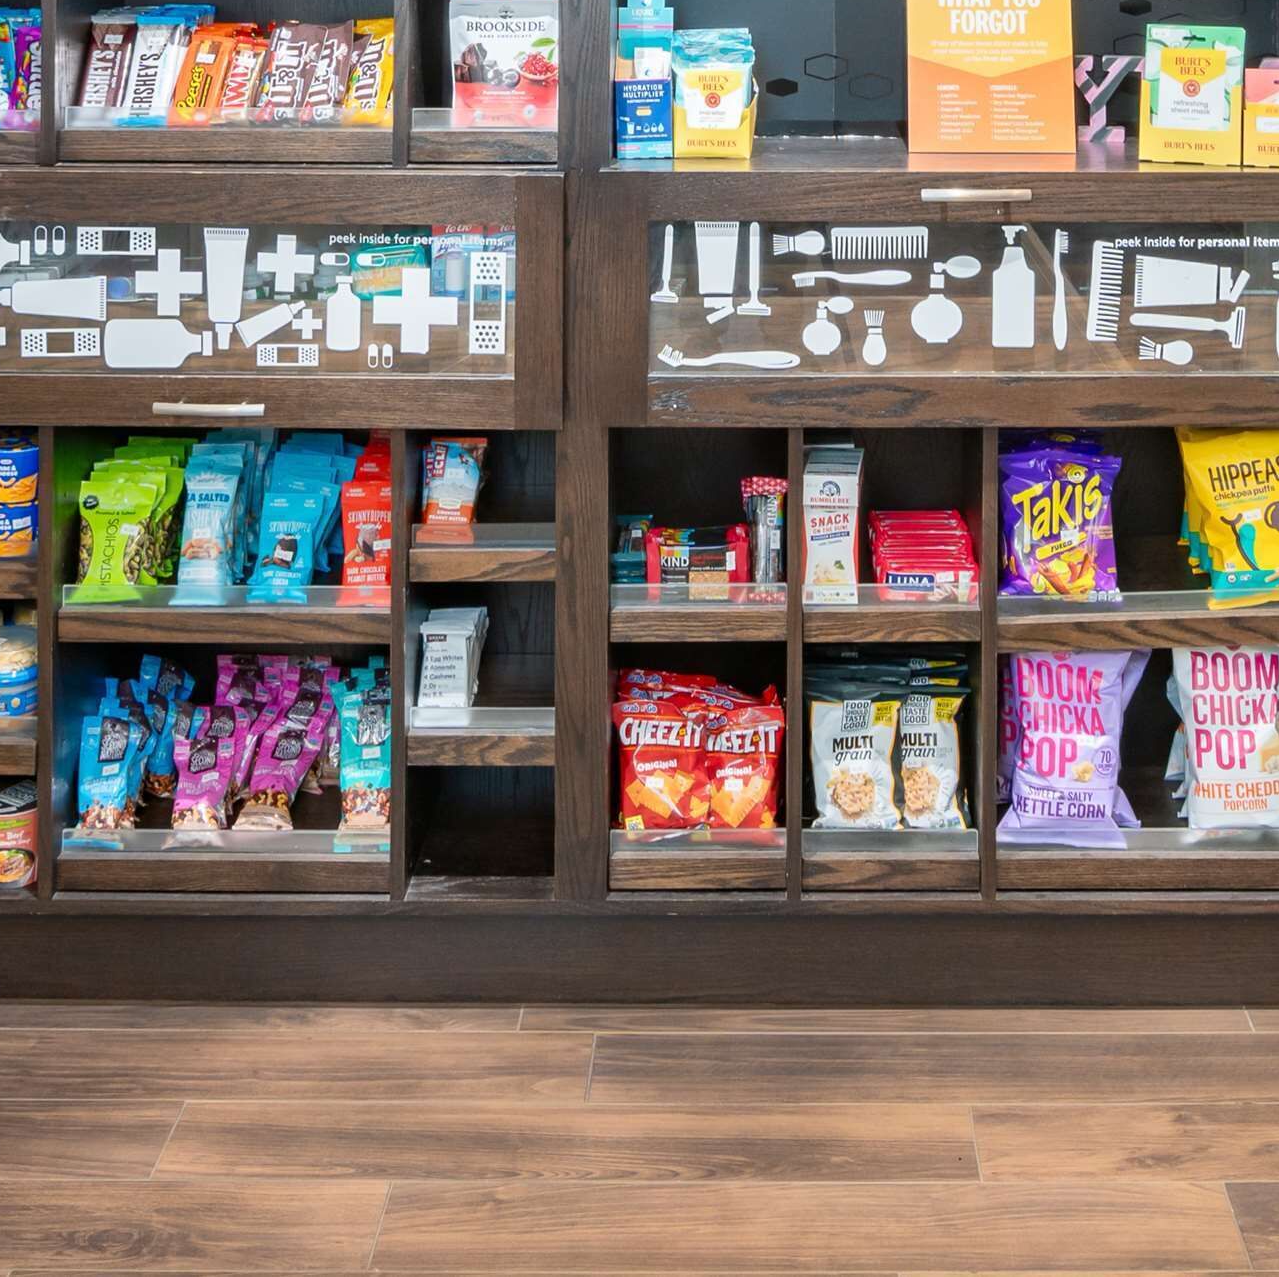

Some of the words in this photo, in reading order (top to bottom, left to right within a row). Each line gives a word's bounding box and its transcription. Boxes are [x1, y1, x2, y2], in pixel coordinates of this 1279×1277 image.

[466, 21, 546, 33] BROOKSIDE
[949, 9, 1029, 34] FORGOT
[1175, 56, 1211, 66] BURT'S
[1180, 66, 1206, 76] BEES
[82, 49, 114, 108] ERSHEY'S
[698, 75, 729, 83] BURT'S
[623, 84, 663, 92] HYDRATION
[703, 83, 725, 91] BEES
[622, 91, 664, 99] MULTIPLIER
[687, 139, 714, 147] BURT'S
[716, 139, 737, 147] BEES
[1164, 141, 1193, 150] BURT'S
[1195, 141, 1215, 151] BEES
[329, 233, 356, 245] peek
[359, 233, 390, 244] inside
[394, 233, 410, 244] for
[1115, 236, 1141, 249] peek
[1144, 236, 1176, 248] inside
[1178, 236, 1196, 248] for
[1197, 236, 1250, 249] personal
[198, 493, 230, 502] SALTED
[1214, 489, 1253, 501] chickpea
[1254, 486, 1275, 498] puffs
[810, 513, 849, 528] SNACK
[661, 556, 689, 567] KIND
[888, 574, 932, 588] LUNA
[1190, 651, 1279, 692] BOOM
[1016, 657, 1104, 704] BOOM
[846, 701, 869, 709] FOOD
[1192, 693, 1279, 727] CHICKA
[1018, 700, 1105, 736] CHICKA
[844, 722, 866, 730] GOOD
[707, 721, 779, 753] EEZ-IT
[833, 735, 873, 753] MULTI
[901, 733, 937, 747] MULTI
[902, 747, 936, 762] grain
[1194, 728, 1257, 771] POP
[835, 750, 872, 766] grain
[1021, 735, 1078, 779] POP
[1100, 751, 1111, 764] 70
[1028, 786, 1057, 800] SWEET
[1067, 791, 1093, 802] SALTY
[1194, 782, 1232, 798] WHITE
[1014, 795, 1064, 818] KETTLE
[1067, 803, 1106, 819] CORN
[1223, 799, 1269, 811] POPCORN
